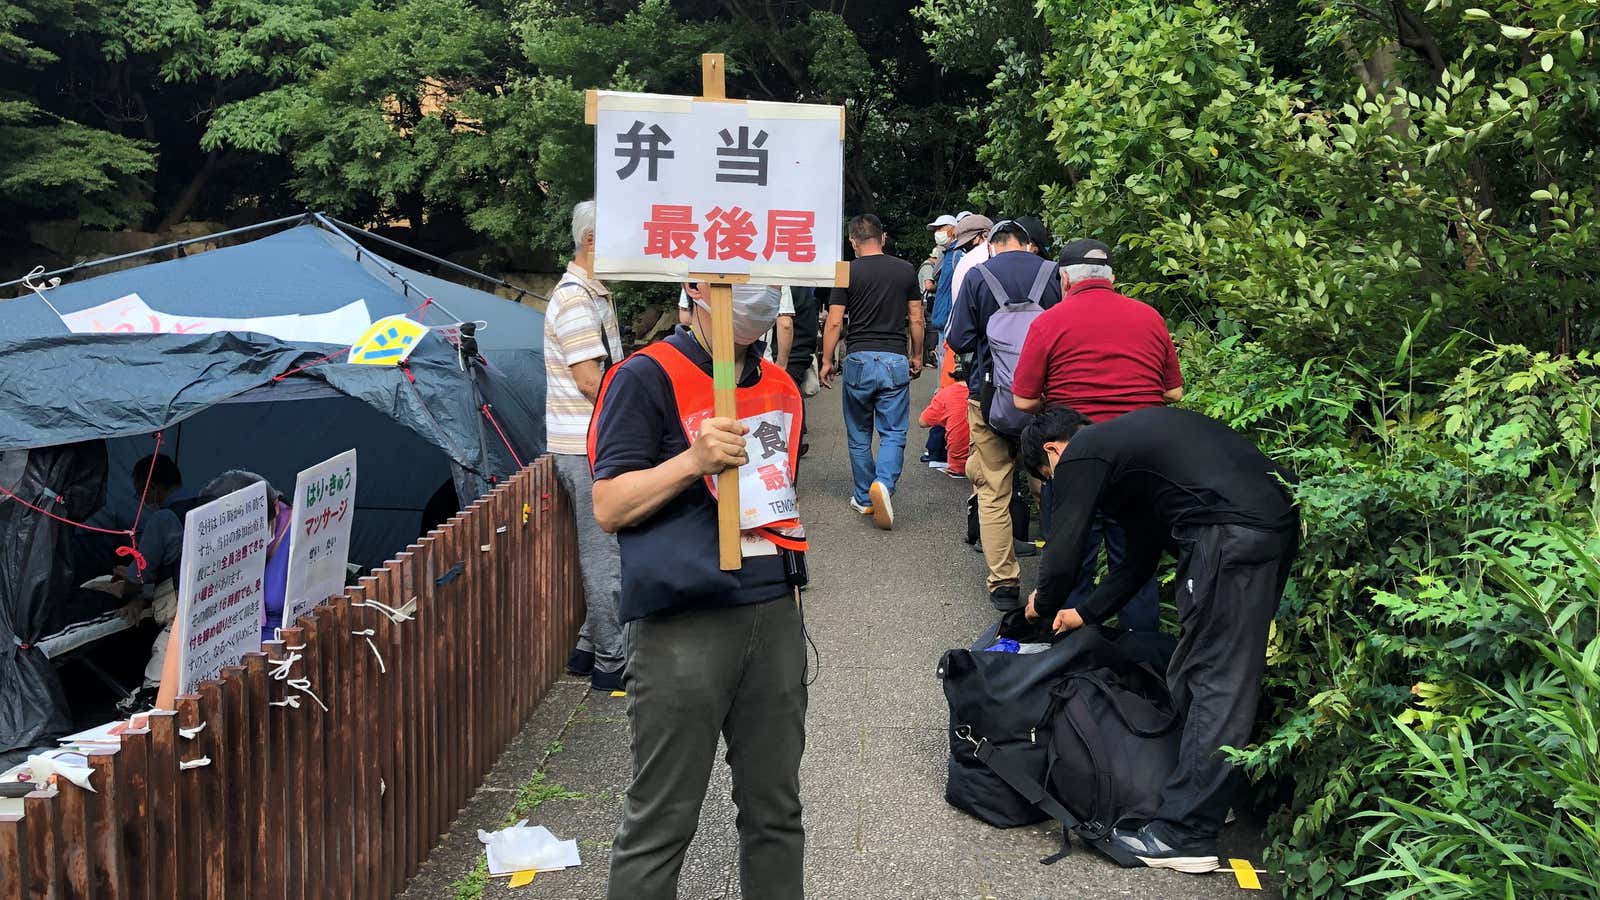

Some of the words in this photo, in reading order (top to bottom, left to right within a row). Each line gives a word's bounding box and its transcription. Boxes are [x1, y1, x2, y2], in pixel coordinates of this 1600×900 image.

[614, 120, 769, 187] 弁当
[643, 204, 817, 263] 最後尾
[745, 421, 787, 464] 食
[306, 467, 351, 508] はり・きゅう
[305, 497, 348, 537] マッサージ
